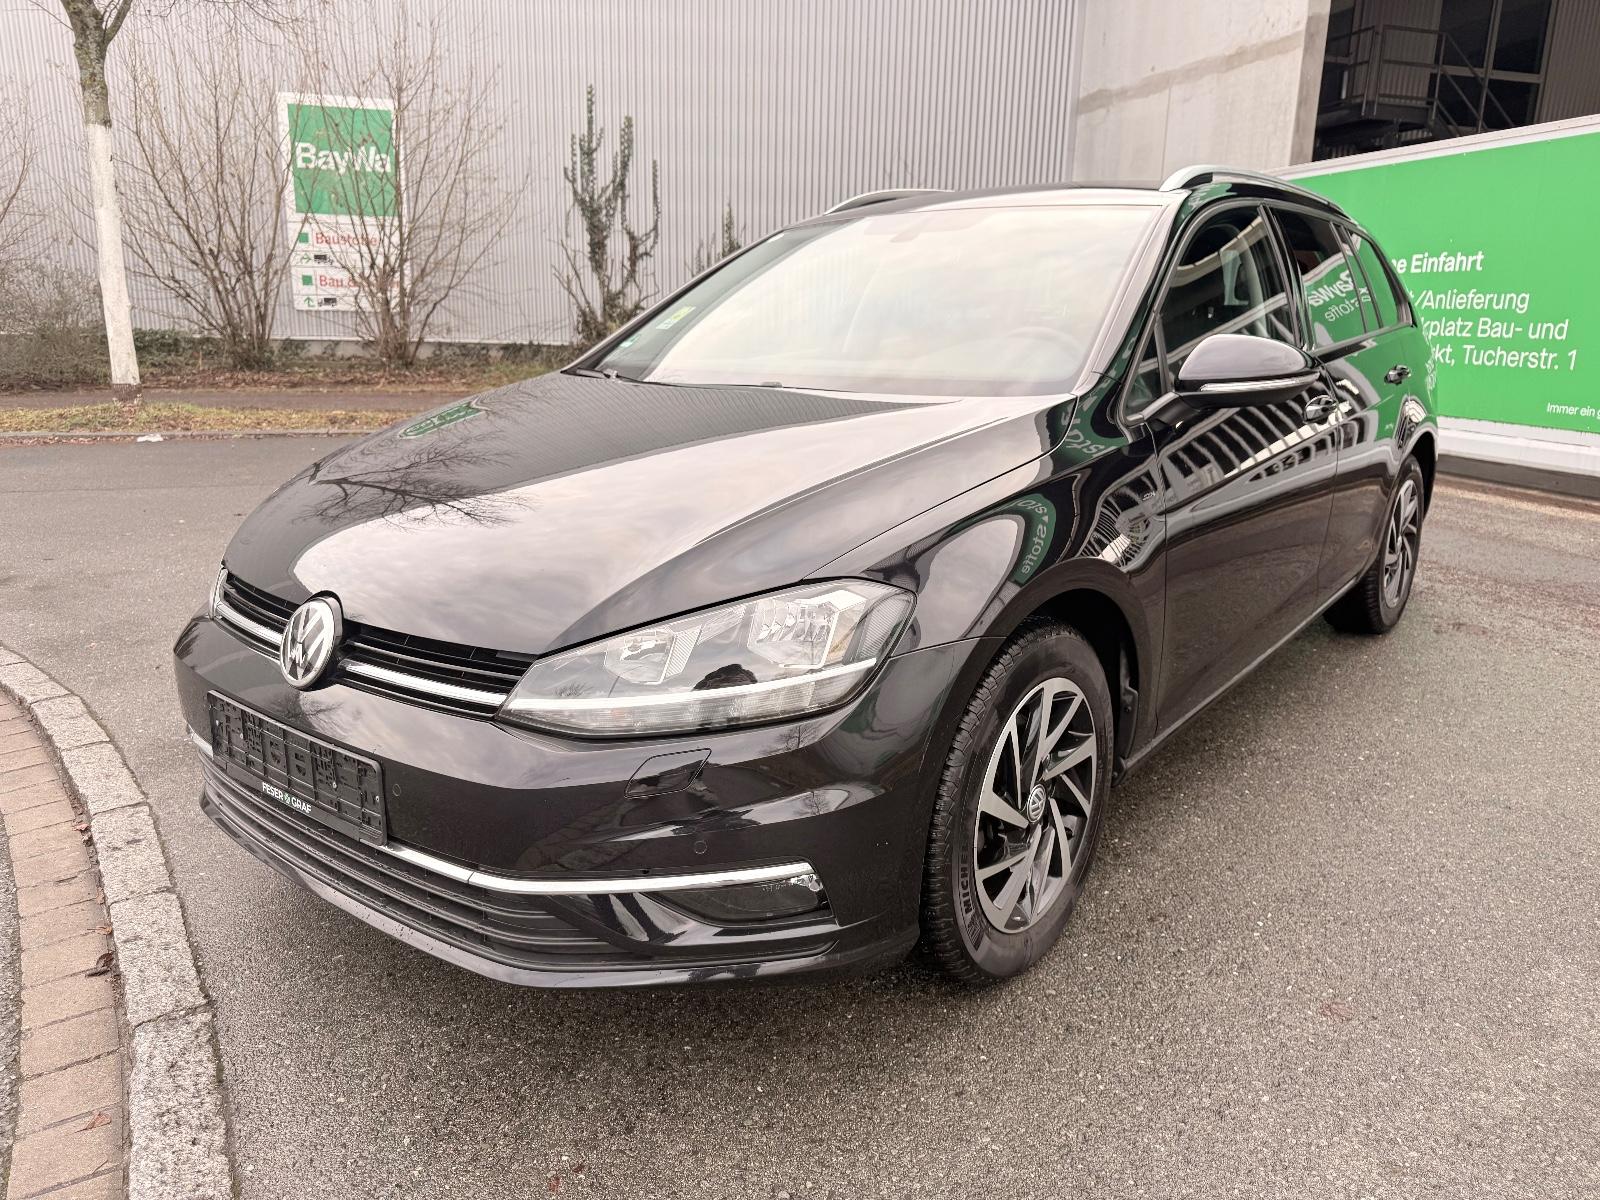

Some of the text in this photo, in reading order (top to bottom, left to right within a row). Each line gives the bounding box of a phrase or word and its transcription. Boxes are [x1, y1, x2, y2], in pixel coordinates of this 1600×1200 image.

[294, 141, 391, 175] BayWa
[1410, 251, 1484, 273] Einfahrt
[319, 275, 343, 287] Bau
[1477, 317, 1522, 339] Bau-
[1528, 319, 1569, 340] und
[1463, 345, 1559, 370] Tucherstr.
[1568, 349, 1577, 371] 1
[1547, 402, 1579, 415] Immer
[1580, 405, 1595, 417] ein
[262, 782, 283, 800] FESER
[291, 797, 311, 813] GRAF
